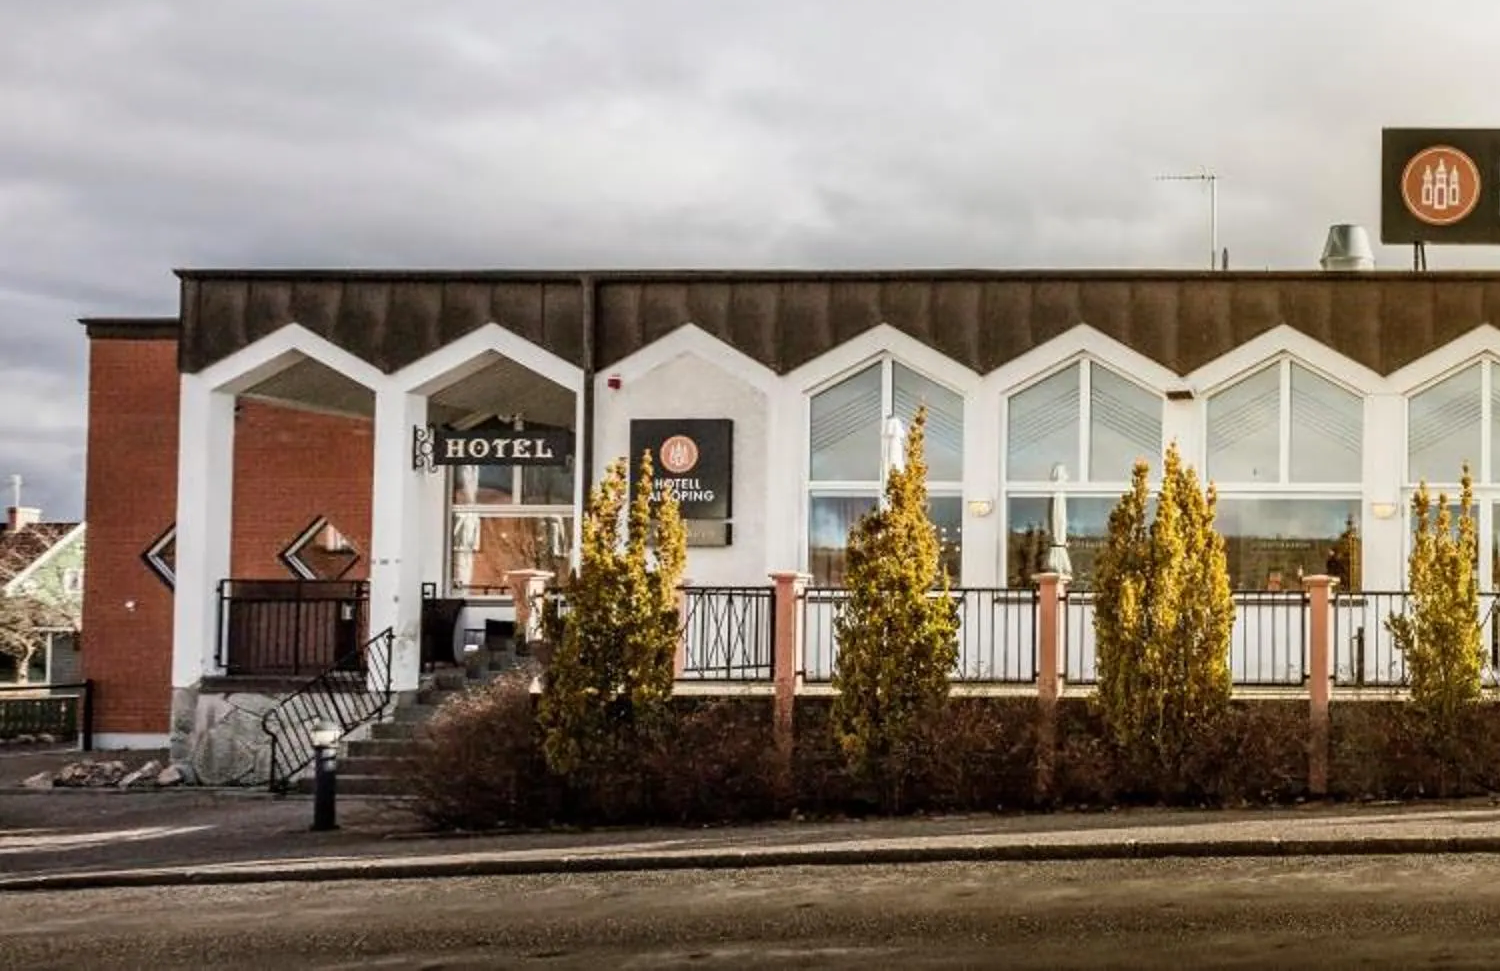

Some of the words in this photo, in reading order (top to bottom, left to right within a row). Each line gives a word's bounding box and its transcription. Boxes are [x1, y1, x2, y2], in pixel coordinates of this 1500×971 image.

[445, 438, 553, 458] HOTEL
[654, 478, 702, 490] HOTELL
[647, 489, 715, 502] ALÖPING
